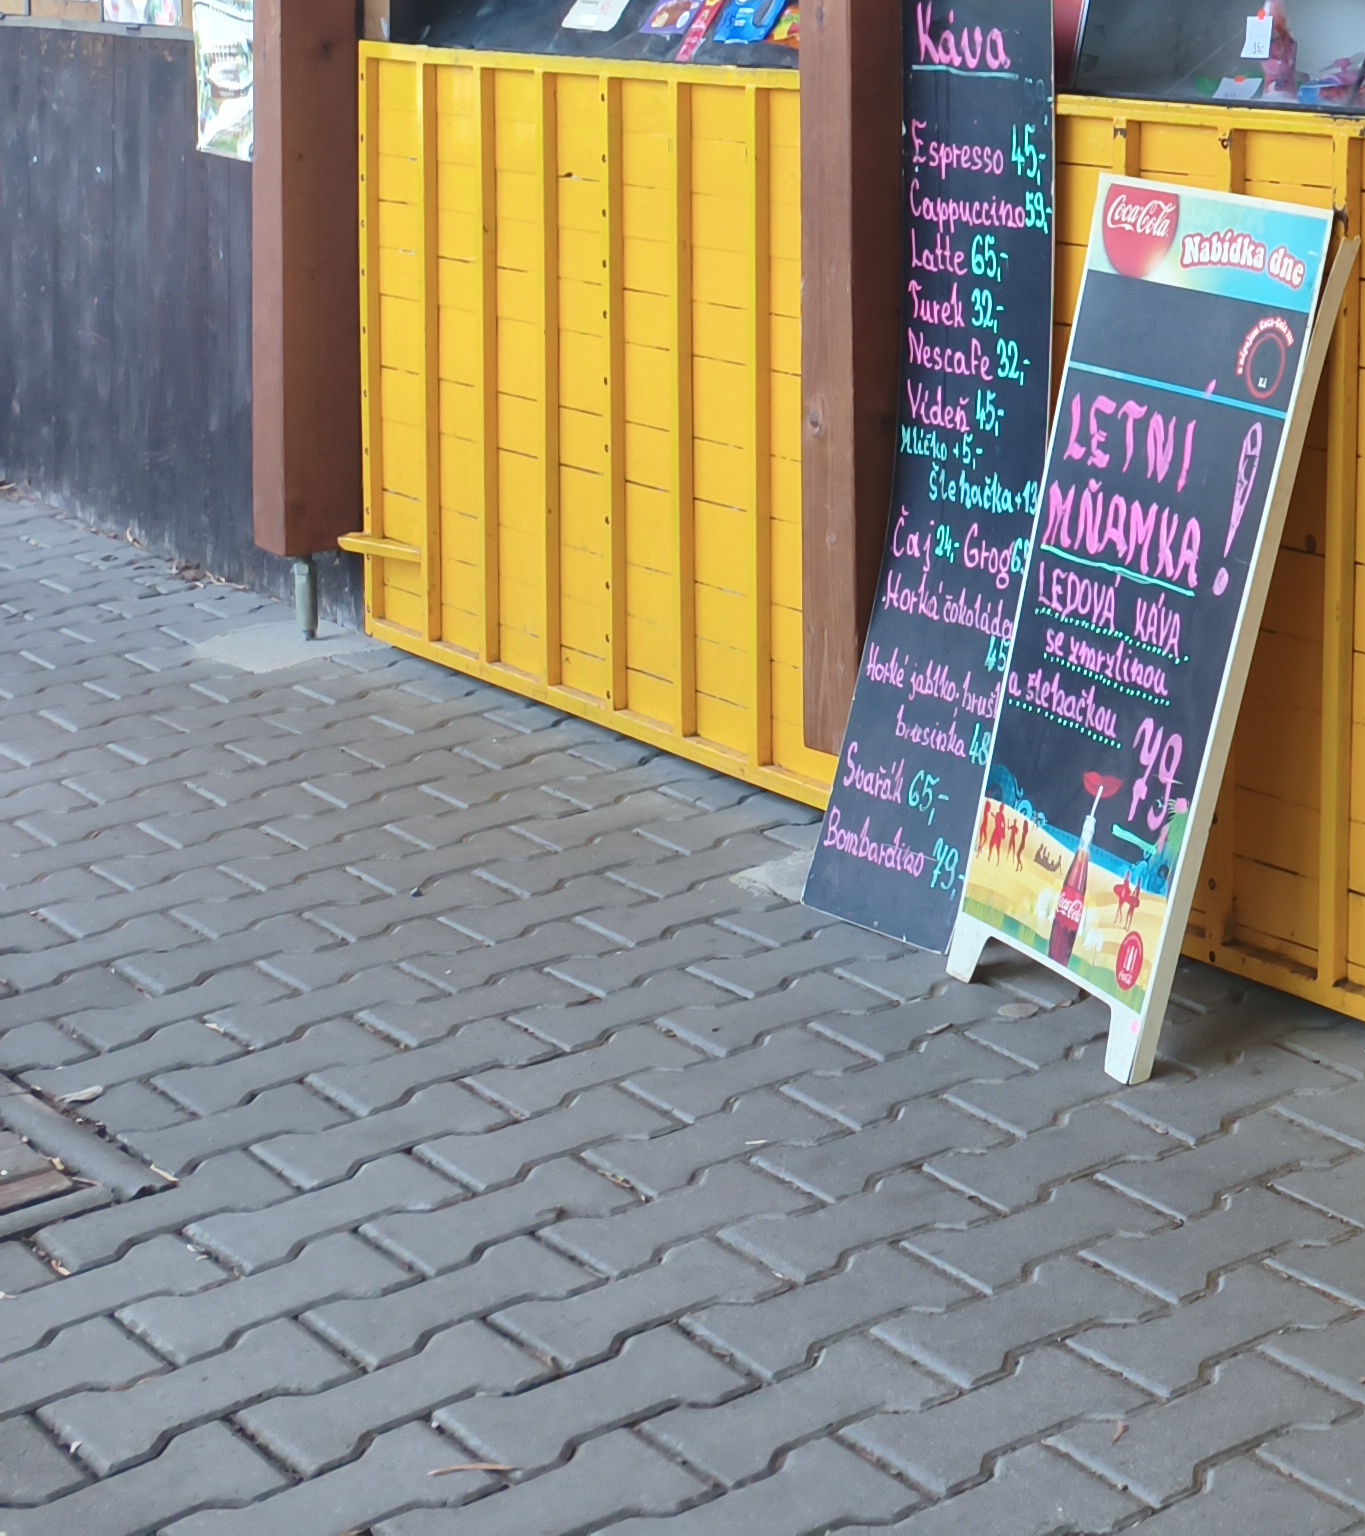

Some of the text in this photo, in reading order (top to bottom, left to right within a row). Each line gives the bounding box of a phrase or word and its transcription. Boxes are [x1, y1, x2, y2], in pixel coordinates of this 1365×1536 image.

[915, 0, 1011, 70] Káva
[911, 118, 1048, 186] Espresso 45,-
[909, 177, 1053, 235] Cappuccino 59,-
[1106, 193, 1176, 239] Coca-Cola
[911, 228, 1009, 283] Latte 65,-
[1182, 229, 1306, 289] Nabídka dne
[908, 279, 1004, 334] Turek 32,-
[907, 327, 1031, 386] Nescafe 32,-
[907, 379, 1006, 438] Vídeň 45,-
[1062, 379, 1217, 493] LETNÍ
[890, 505, 931, 572] Čaj
[963, 522, 1015, 590] Grog
[1041, 478, 1202, 589] MŇAMKA
[883, 569, 1014, 640] Horká čokoláda
[1037, 561, 1182, 658] LEDOVÁ KÁVA
[866, 641, 909, 689] Horké
[1045, 627, 1064, 657] se
[1008, 670, 1119, 741] a šlehačkou
[843, 740, 950, 827] Svařák 65,-
[822, 805, 925, 878] Bombardino
